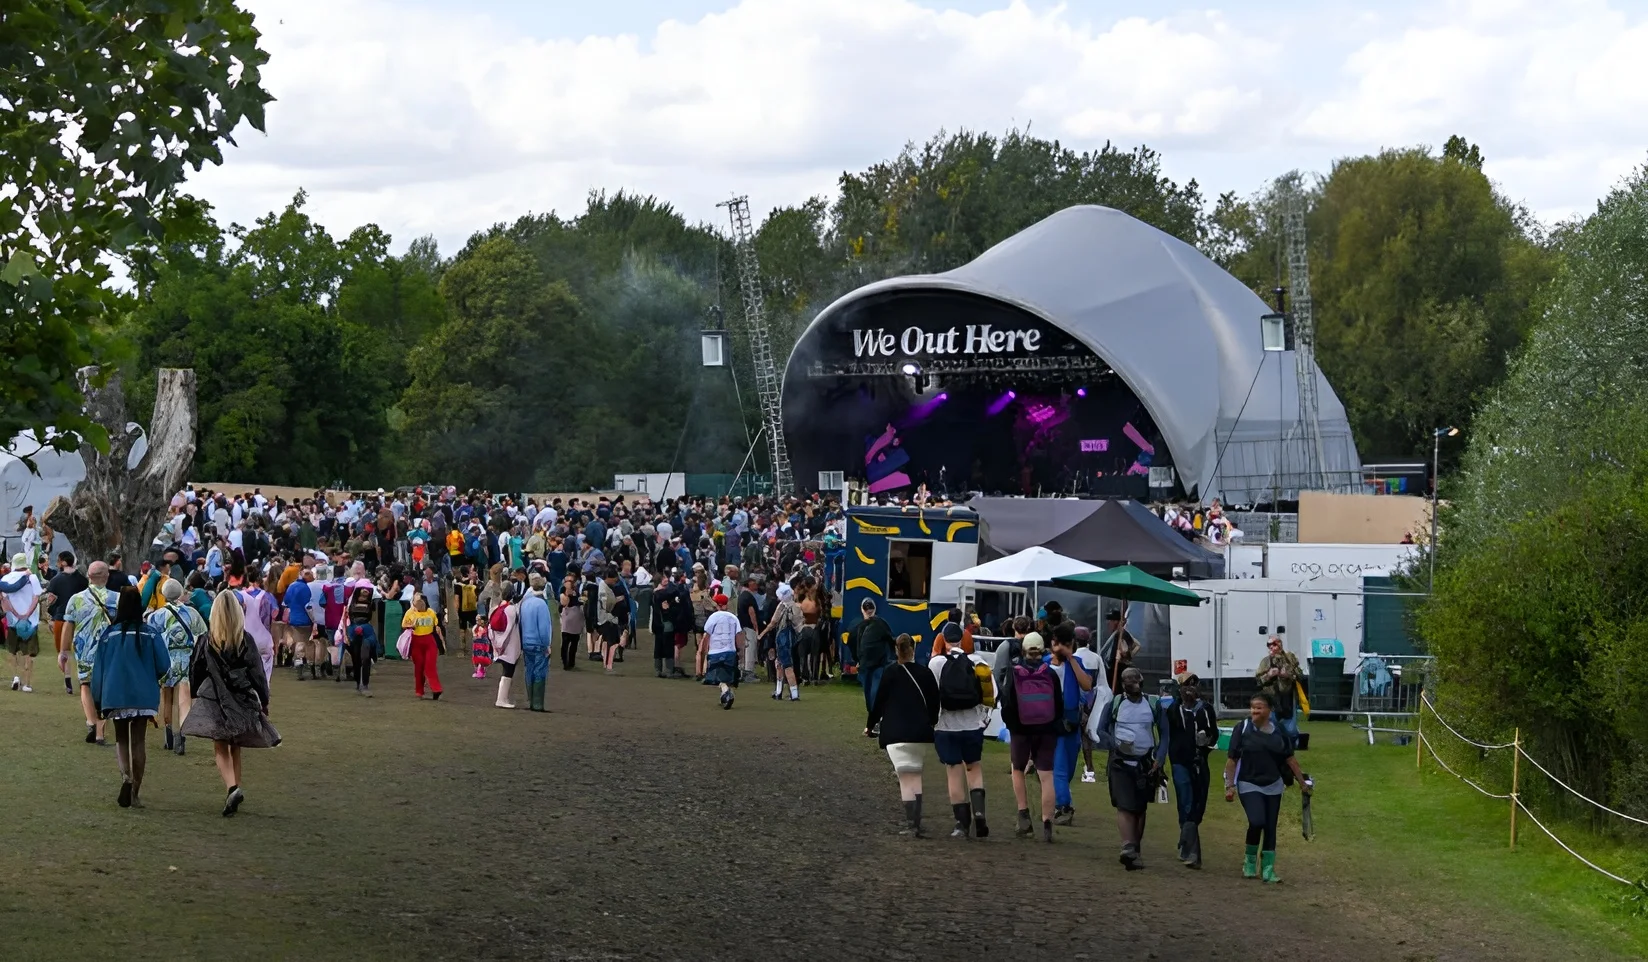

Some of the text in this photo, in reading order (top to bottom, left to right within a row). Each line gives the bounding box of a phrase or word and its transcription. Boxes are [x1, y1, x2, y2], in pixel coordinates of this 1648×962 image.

[853, 324, 1041, 357] We Out Here
